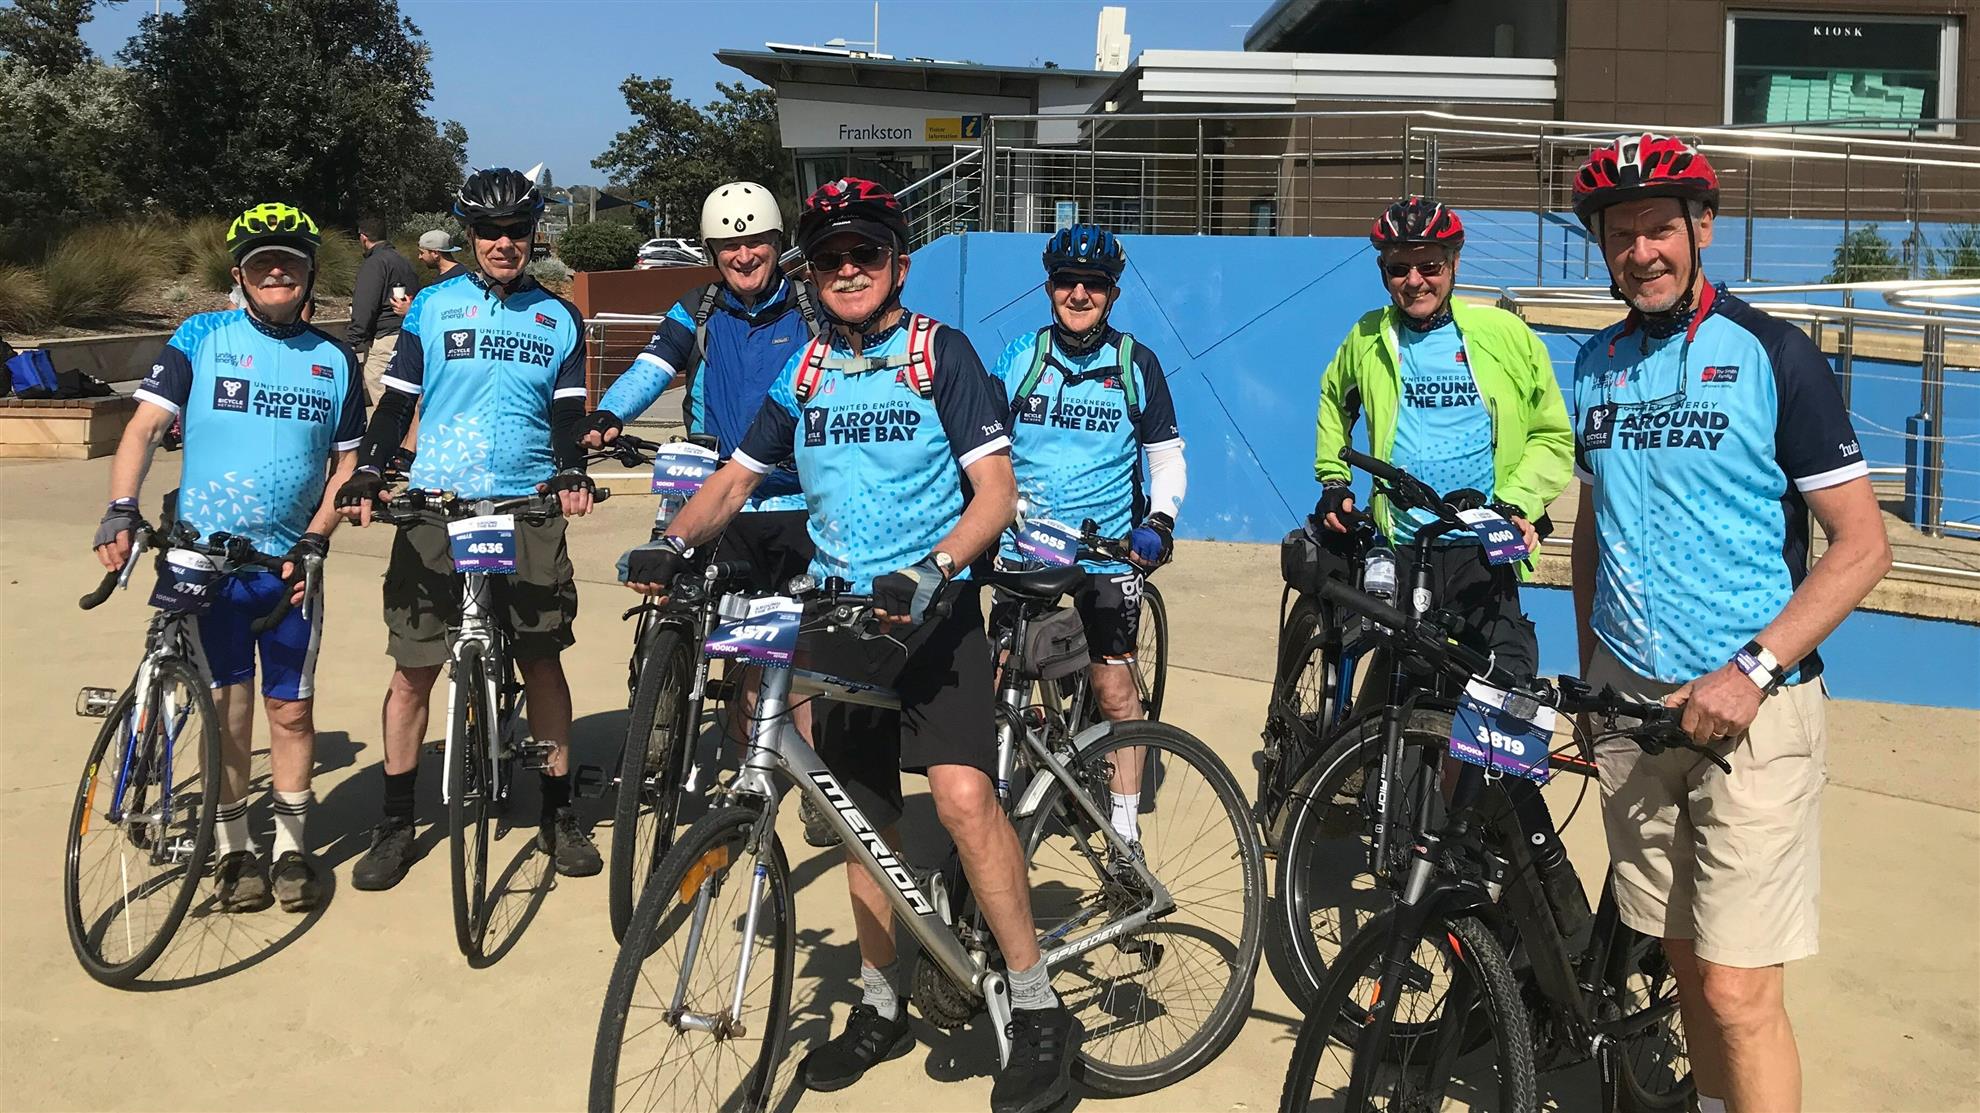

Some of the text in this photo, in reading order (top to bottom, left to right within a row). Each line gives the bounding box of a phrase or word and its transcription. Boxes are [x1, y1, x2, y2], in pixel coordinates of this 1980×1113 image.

[1813, 25, 1863, 37] KIOSK
[838, 124, 912, 140] Frankston
[516, 331, 548, 342] ENERGY
[480, 335, 555, 356] AROUND
[479, 347, 553, 368] THE BAY
[254, 381, 326, 397] UNITED ENERGY
[1404, 382, 1478, 396] AROUND
[218, 398, 244, 406] BICYCLE
[254, 390, 331, 412] AROUND
[832, 400, 910, 412] UNITED ENERGY
[1052, 397, 1116, 408] UITED ENERGY
[1404, 394, 1481, 409] THE BAY
[1670, 401, 1719, 410] ENERGY
[253, 402, 328, 424] THE BAY
[829, 409, 921, 428] AROUND
[1620, 411, 1729, 430] AROUND
[981, 420, 1004, 437] hub
[1050, 414, 1120, 433] THE BAY
[829, 427, 870, 444] THE
[875, 425, 917, 442] BAY
[1618, 429, 1725, 451] THE BAY
[1838, 440, 1859, 458] hub
[666, 465, 703, 478] 4744
[1030, 530, 1066, 551] 4055
[1488, 530, 1514, 544] 4060
[467, 543, 504, 554] 4636
[711, 643, 738, 653] 100KM
[1476, 725, 1525, 756] 3819
[811, 774, 934, 915] MERIDA
[1045, 923, 1123, 965] SPEEDER
